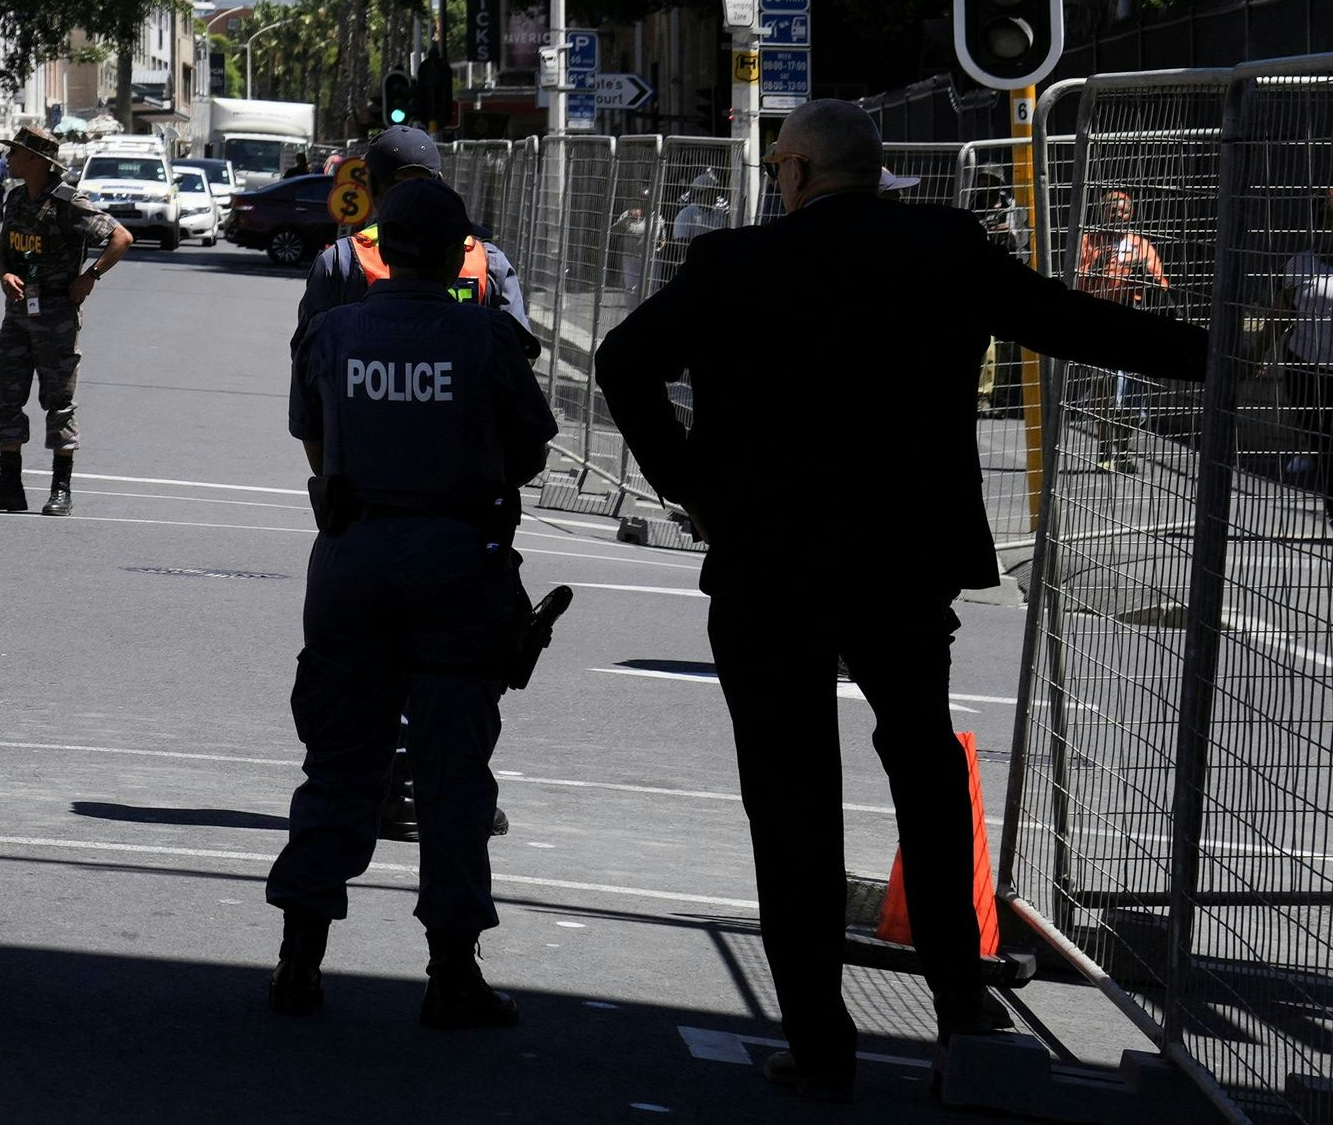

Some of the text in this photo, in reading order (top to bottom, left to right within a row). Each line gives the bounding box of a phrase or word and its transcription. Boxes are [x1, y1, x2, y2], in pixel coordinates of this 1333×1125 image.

[734, 11, 747, 21] Zone
[575, 36, 589, 52] P
[597, 94, 623, 104] ourt
[1018, 102, 1028, 121] 6
[340, 191, 359, 216] S
[9, 230, 42, 253] POLICE
[347, 358, 454, 402] POLICE
